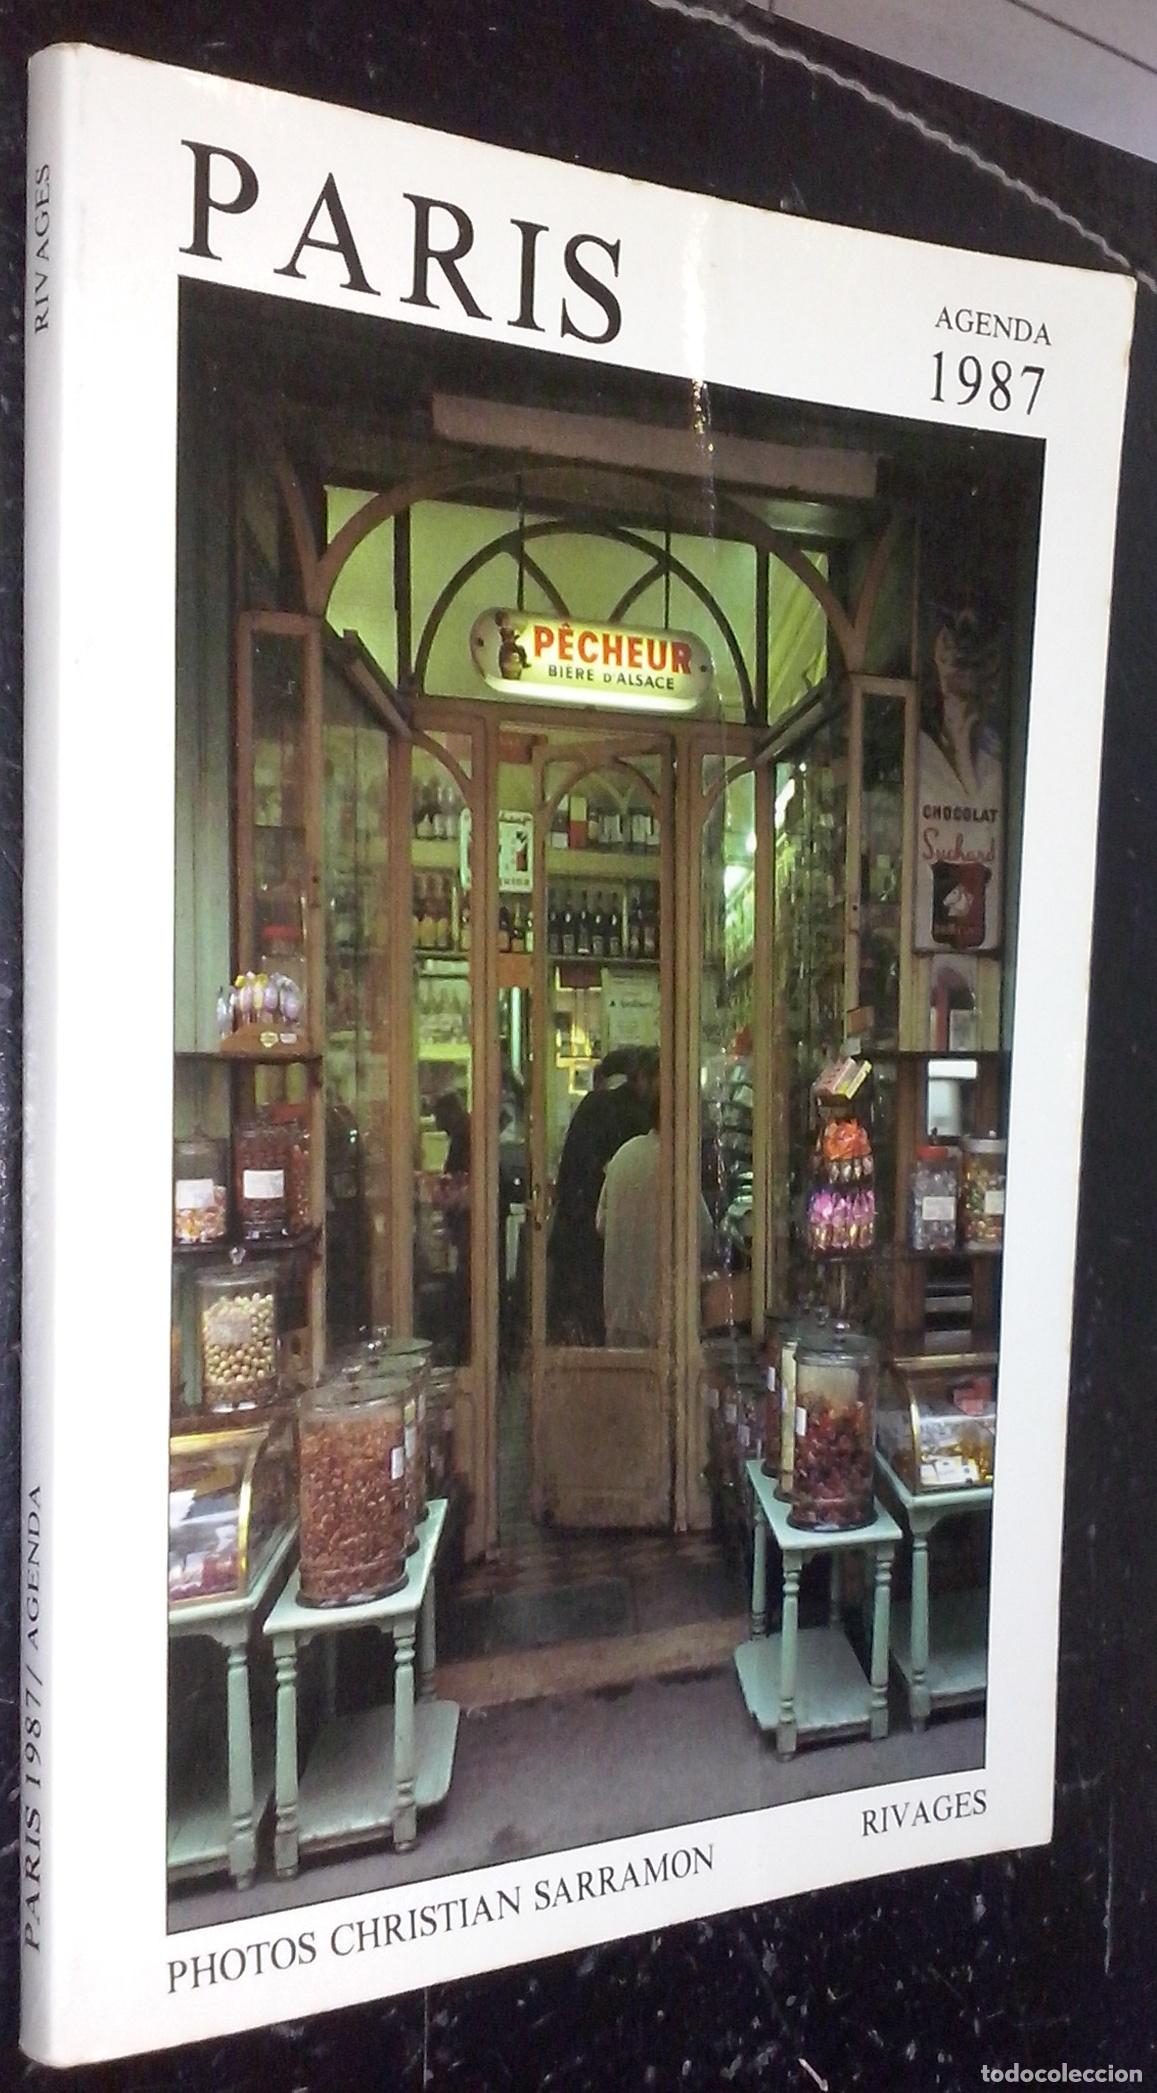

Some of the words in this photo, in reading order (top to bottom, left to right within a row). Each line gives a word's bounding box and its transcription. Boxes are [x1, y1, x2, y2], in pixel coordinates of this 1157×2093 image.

[34, 164, 50, 333] RIVAGES
[179, 139, 623, 345] PARIS
[934, 306, 1052, 346] AGENDA
[930, 351, 1045, 415] 1987
[533, 622, 693, 675] PÊCHEUR
[922, 804, 999, 823] CHOCOLAT
[27, 1486, 42, 1651] AGENDA
[861, 1789, 988, 1837] RIVAGES
[24, 1804, 42, 1953] PARIS
[166, 1931, 318, 1993] PHOTOS
[330, 1886, 522, 1957] CHRISTIAN
[534, 1844, 715, 1912] SARRAMON
